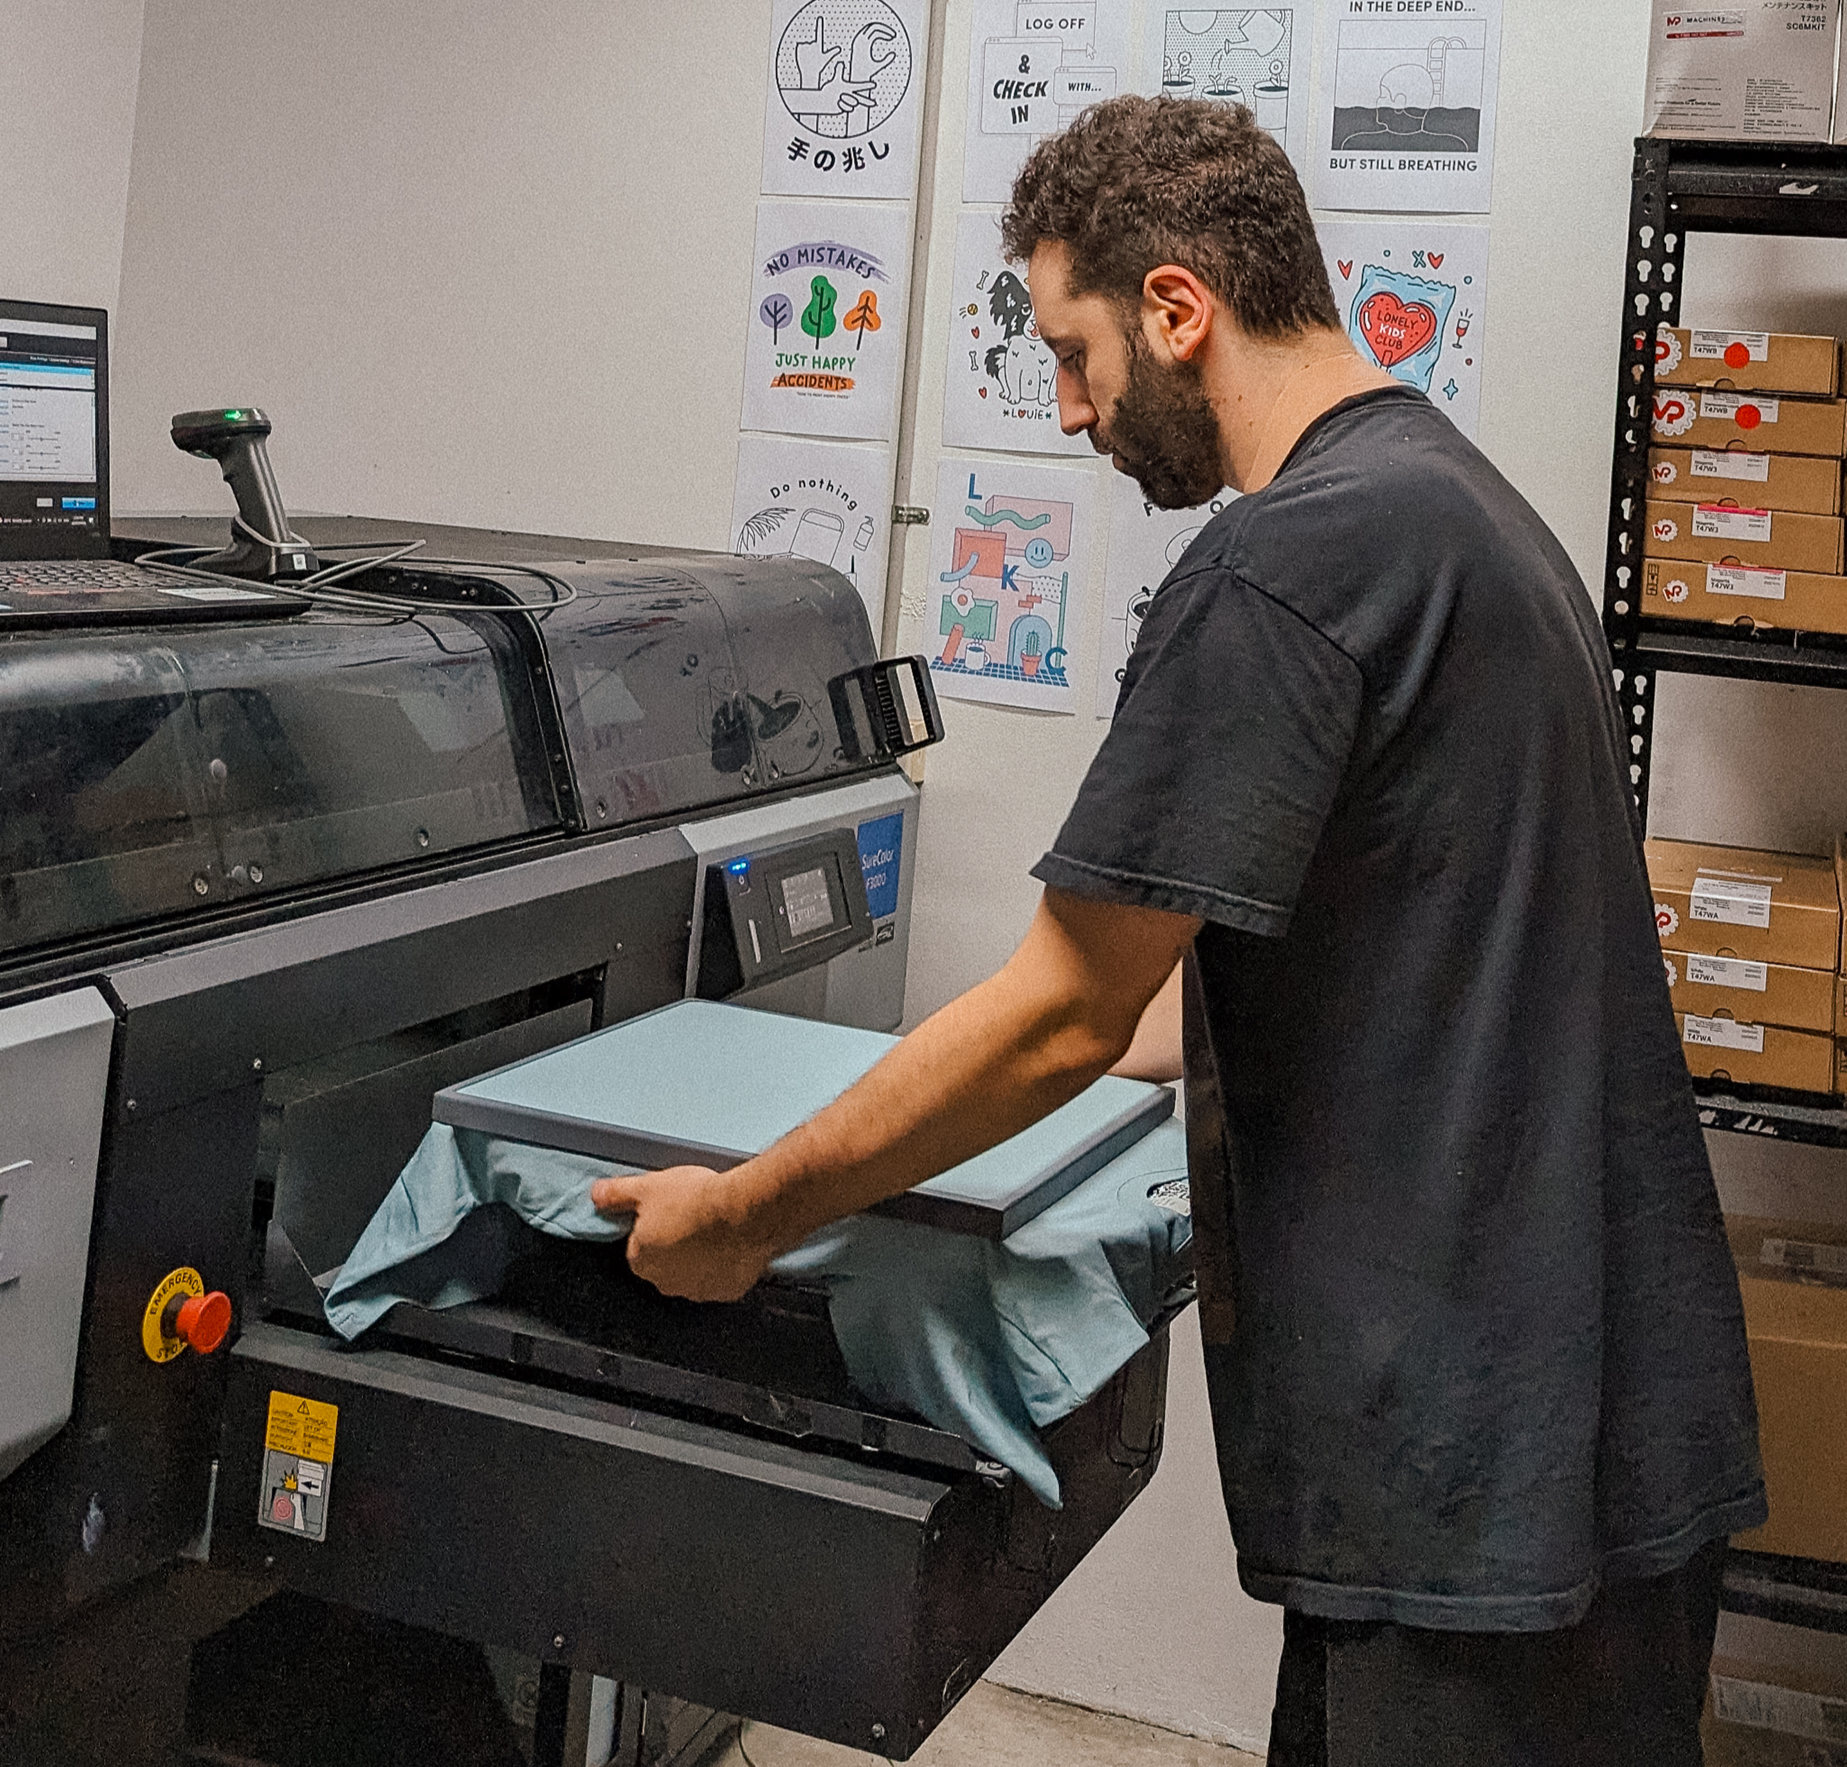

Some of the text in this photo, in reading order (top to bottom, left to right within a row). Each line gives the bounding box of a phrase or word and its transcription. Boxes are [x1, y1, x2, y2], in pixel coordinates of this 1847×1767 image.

[1349, 1, 1364, 12] IN
[1367, 1, 1393, 12] THE
[1397, 1, 1433, 13] DEEP
[1026, 18, 1086, 30] LOG OFF
[1018, 55, 1030, 74] &
[993, 79, 1049, 99] CHECK
[1010, 104, 1029, 124] IN
[787, 136, 890, 174] 手の兆し
[1329, 158, 1478, 171] BUT STILL BREATHING
[766, 246, 875, 279] NO MISTAKES
[1376, 310, 1418, 330] LONELY
[1379, 324, 1406, 339] KIDS
[1375, 334, 1403, 350] CLUB
[775, 352, 856, 372] JUST HAPPY
[777, 372, 848, 390] ACCIDENTS
[770, 478, 857, 511] Do nothing
[968, 473, 982, 500] L
[1002, 564, 1019, 591] K
[1694, 910, 1719, 920] T47WA
[1688, 1033, 1712, 1043] T47WA
[150, 1272, 201, 1315] EMERGENCY
